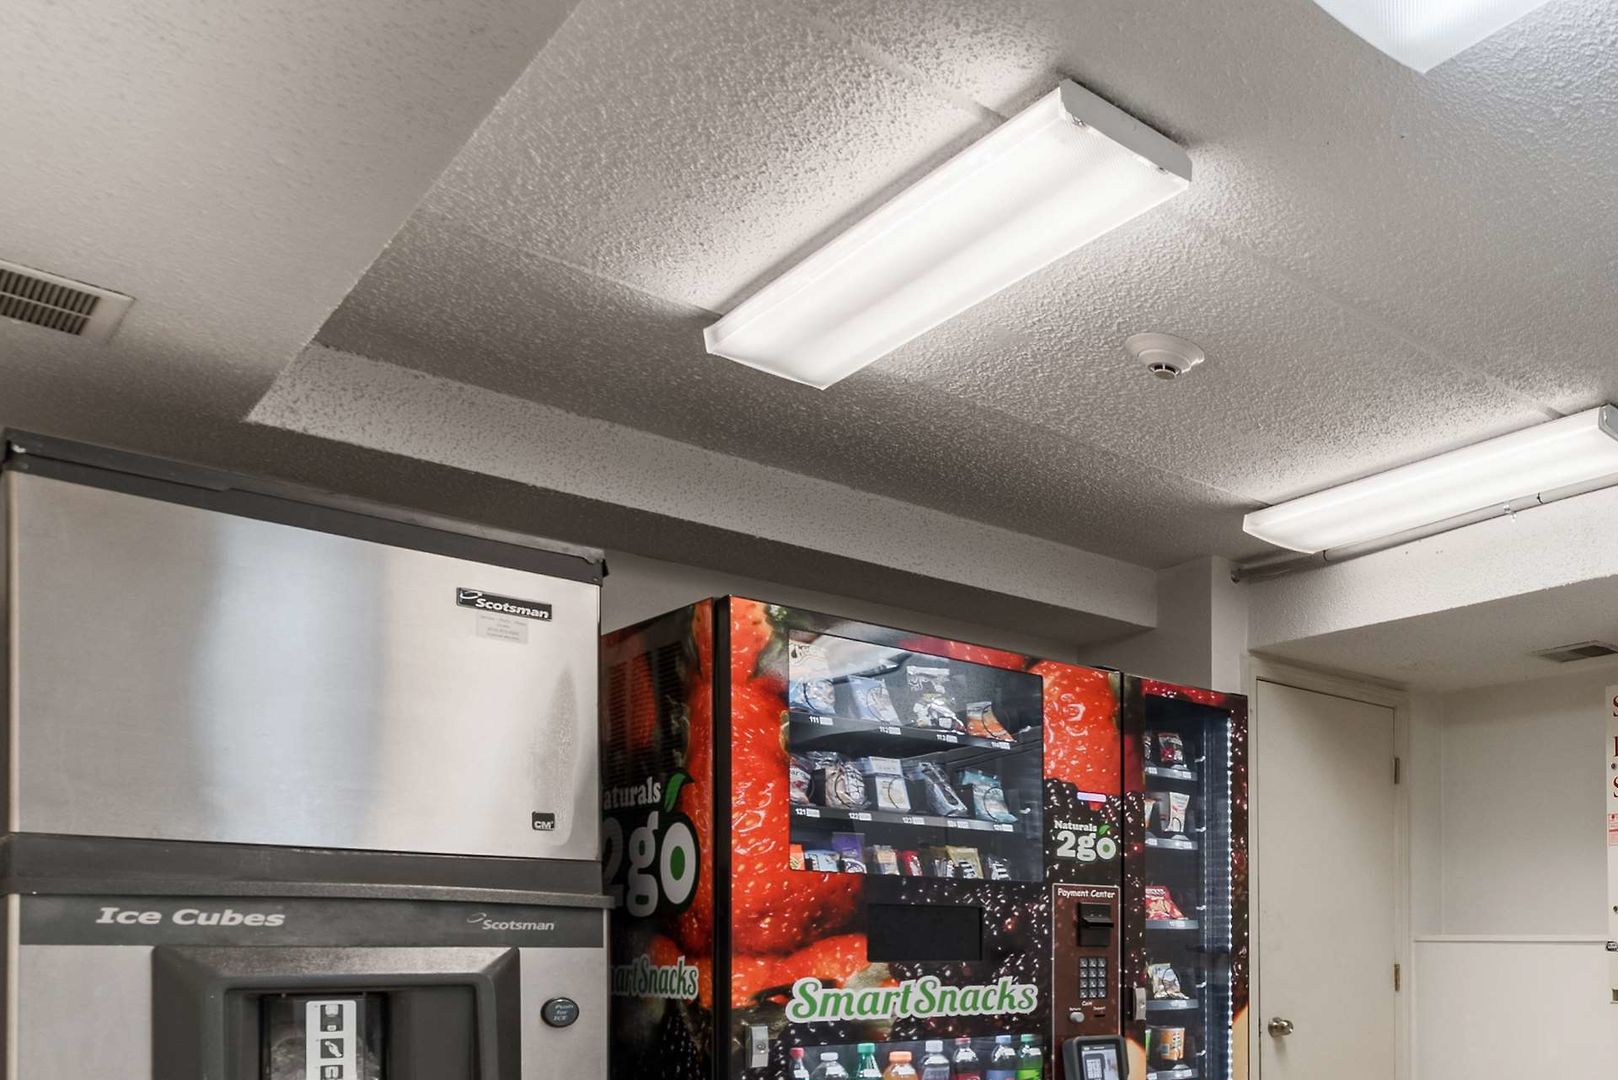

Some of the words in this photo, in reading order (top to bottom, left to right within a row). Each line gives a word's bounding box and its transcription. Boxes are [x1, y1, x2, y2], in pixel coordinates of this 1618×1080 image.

[475, 597, 549, 619] Scotsman
[603, 776, 662, 810] aturals
[1054, 820, 1098, 833] Naturals
[1056, 830, 1117, 862] 2go
[1058, 888, 1089, 898] Payment
[1090, 889, 1116, 898] Center
[96, 906, 162, 925] Ice
[172, 908, 286, 927] Cubes
[482, 919, 555, 931] Scotsman
[613, 957, 699, 999] artSnacks
[788, 977, 1038, 1021] SmartSnacks
